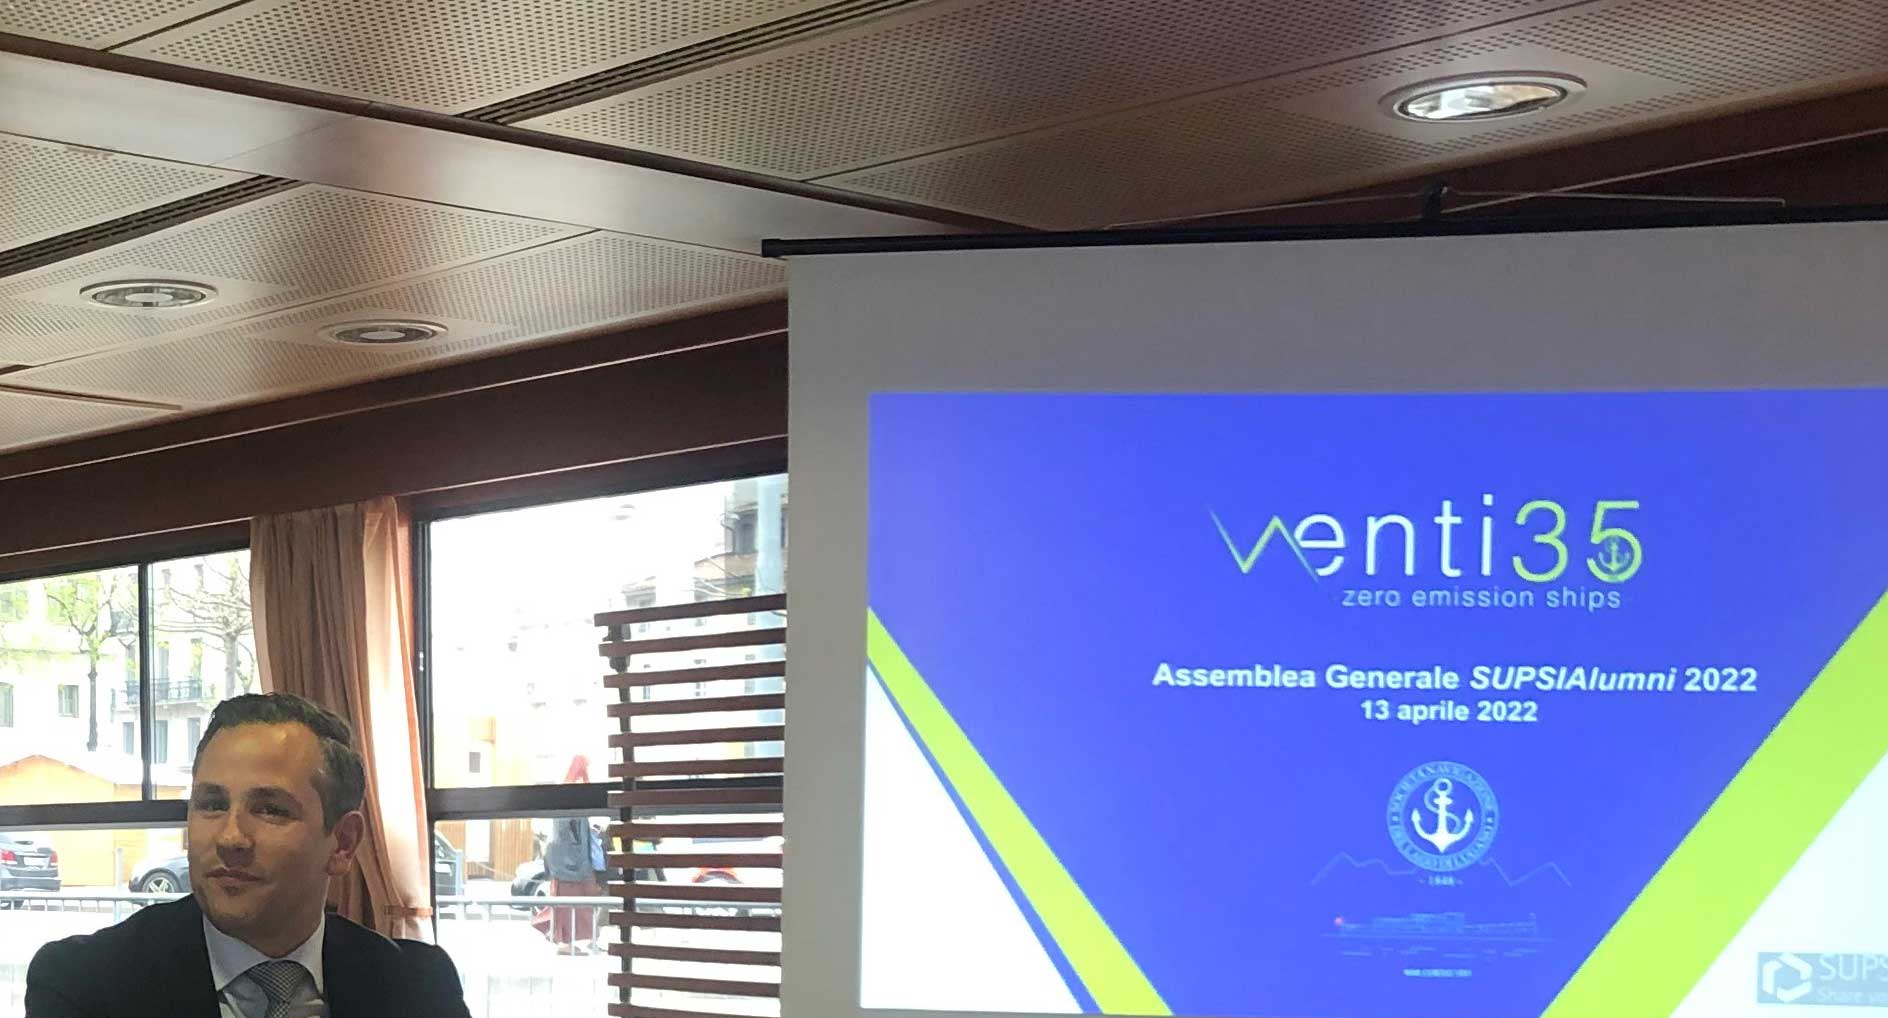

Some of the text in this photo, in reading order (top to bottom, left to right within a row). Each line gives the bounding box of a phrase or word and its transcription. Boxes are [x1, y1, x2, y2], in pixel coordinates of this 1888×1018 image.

[1341, 586, 1621, 612] zero emission ships
[1152, 663, 1758, 692] Assemblea Generale SUPSIAlumni 2022
[1361, 699, 1538, 725] 13 aprile 2022
